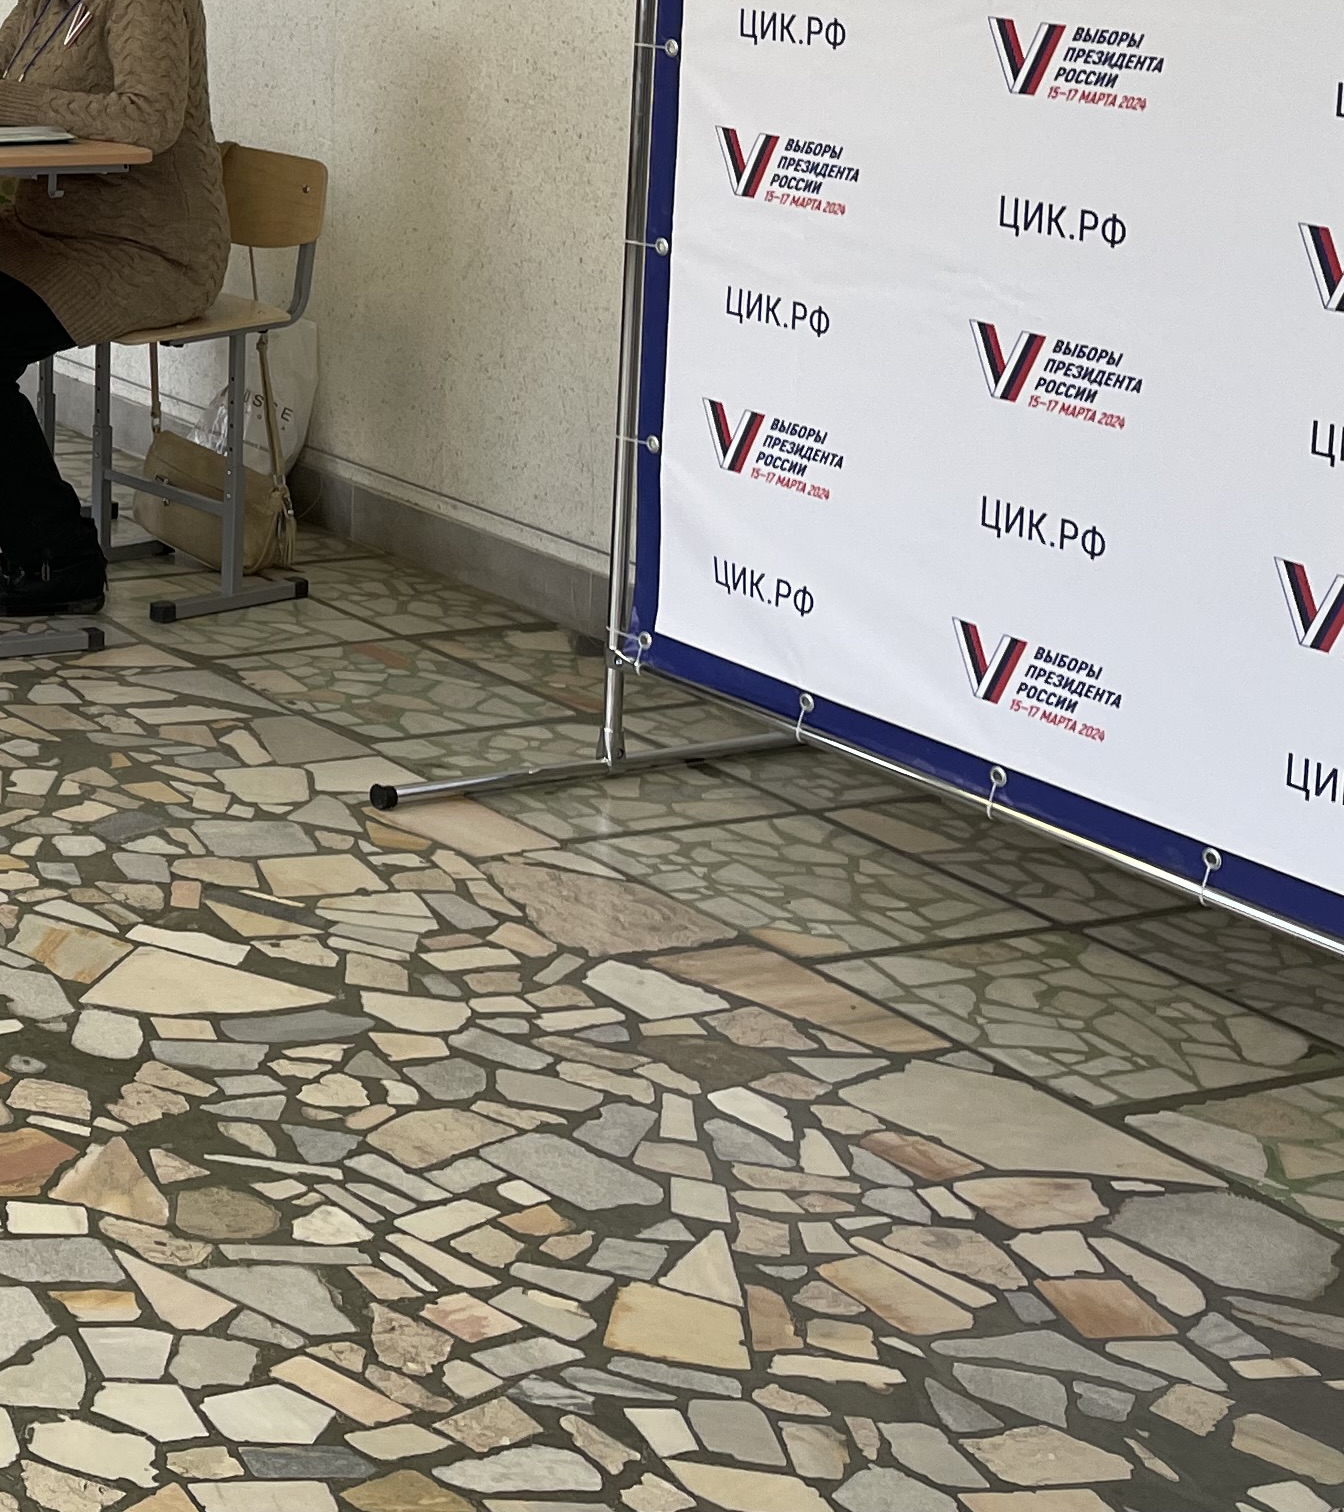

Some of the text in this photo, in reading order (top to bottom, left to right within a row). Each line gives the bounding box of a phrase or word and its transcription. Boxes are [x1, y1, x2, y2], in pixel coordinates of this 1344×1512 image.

[741, 9, 845, 49] ЦИК.РФ
[1072, 25, 1145, 49] ВЫБОРЫ
[1062, 46, 1165, 74] ПРЕЗИДЕНТА
[1053, 66, 1119, 89] РОССИИ
[1078, 89, 1118, 108] МАРТА
[1117, 95, 1148, 112] 2024
[784, 137, 844, 160] ВЫБОРЫ
[777, 155, 860, 183] ПРЕЗИДЕНТА
[769, 173, 824, 195] РОССИИ
[789, 195, 822, 211] МАРТА
[822, 201, 846, 217] 2024
[1000, 196, 1126, 248] ЦИК.РФ
[727, 286, 829, 337] ЦИК.РФ
[1052, 338, 1124, 368] ВЫБОРЫ
[1034, 376, 1099, 404] РОССИИ
[1043, 358, 1144, 394] ПРЕЗИДЕНТА
[770, 417, 829, 445] ВЫБОРЫ
[1058, 402, 1097, 424] МАРТА
[1097, 411, 1126, 431] 2024
[755, 451, 808, 477] РОССИИ
[762, 434, 844, 470] ПРЕЗИДЕНТА
[775, 474, 807, 494] МАРТА
[807, 484, 830, 501] 2024
[982, 496, 1105, 560] ЦИК.РФ
[714, 556, 813, 616] ЦИК.РФ
[1033, 645, 1103, 681] ВЫБОРЫ
[1015, 682, 1079, 714] РОССИИ
[1024, 664, 1123, 709] ПРЕЗИДЕНТА
[1039, 709, 1077, 733] МАРТА
[1077, 722, 1106, 743] 2024
